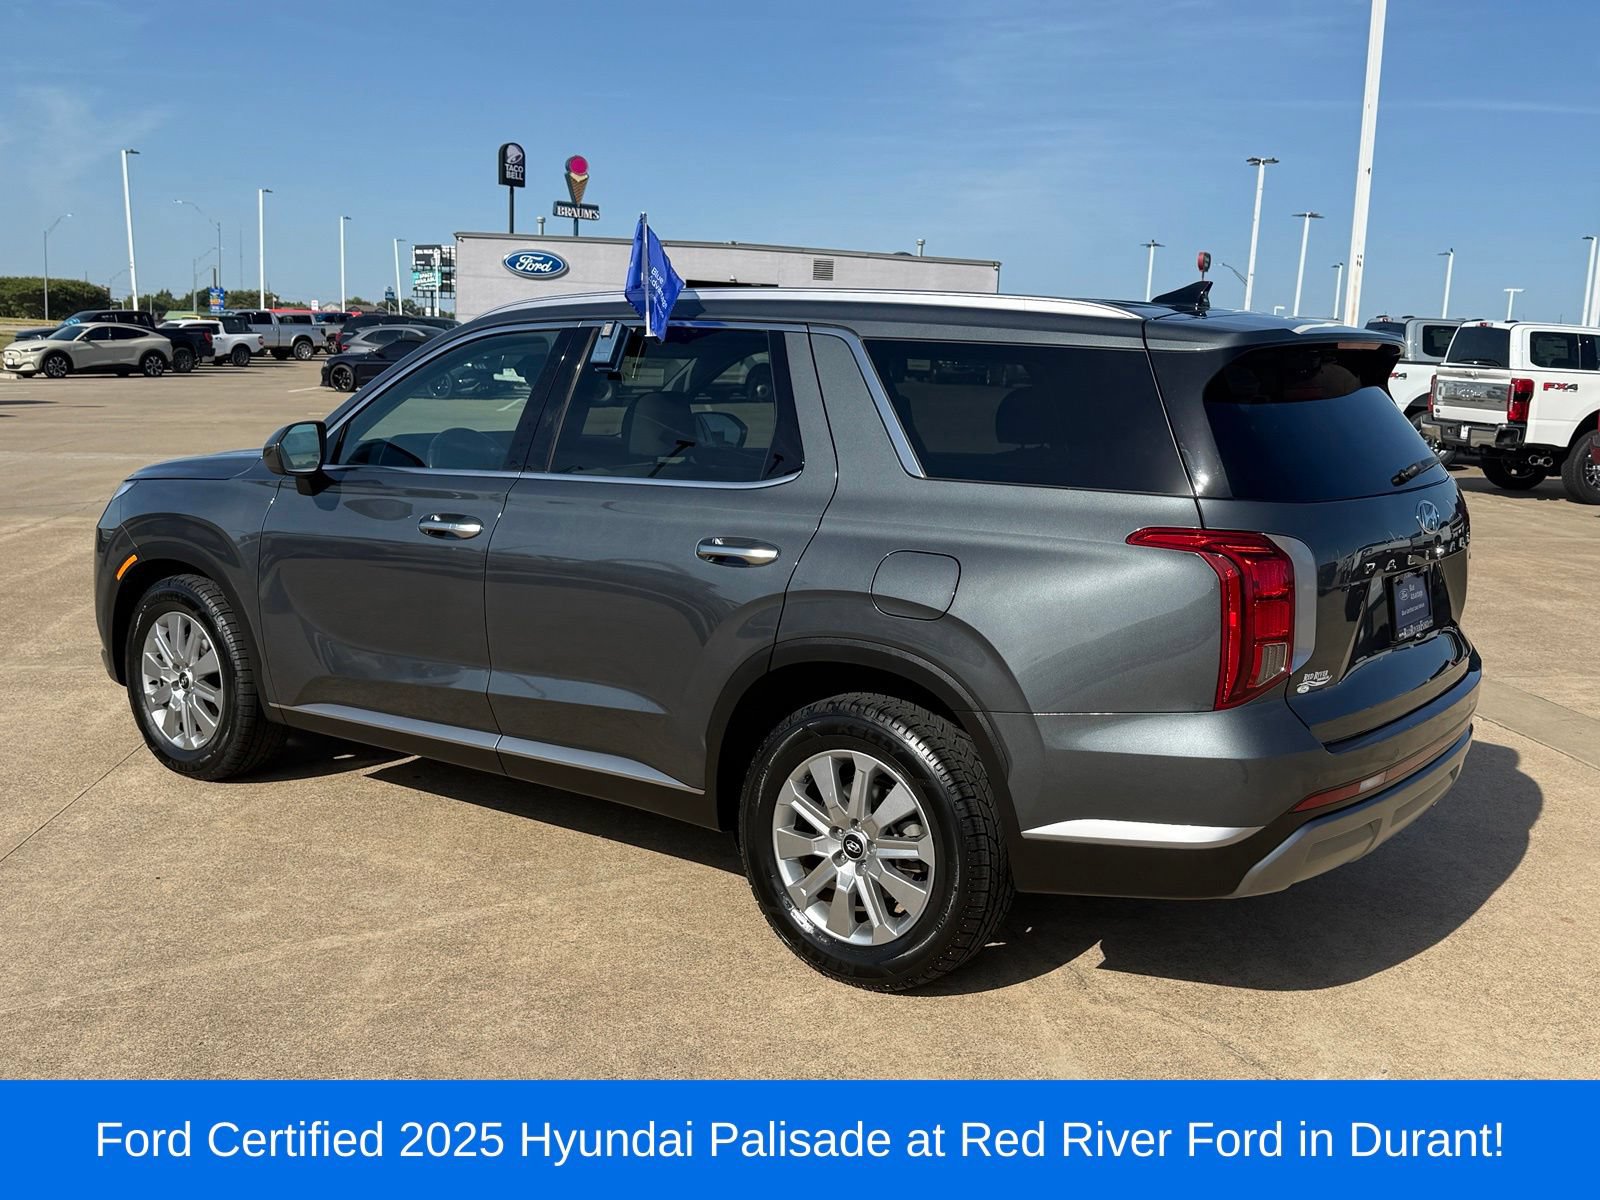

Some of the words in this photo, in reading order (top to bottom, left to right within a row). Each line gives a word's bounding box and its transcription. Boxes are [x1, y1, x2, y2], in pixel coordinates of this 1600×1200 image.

[504, 163, 523, 172] TACO
[506, 170, 523, 180] BELL
[516, 255, 553, 272] Ford
[651, 267, 663, 284] Blue
[1543, 382, 1578, 391] FX4
[1303, 673, 1314, 682] RED
[1314, 670, 1329, 680] RIVER
